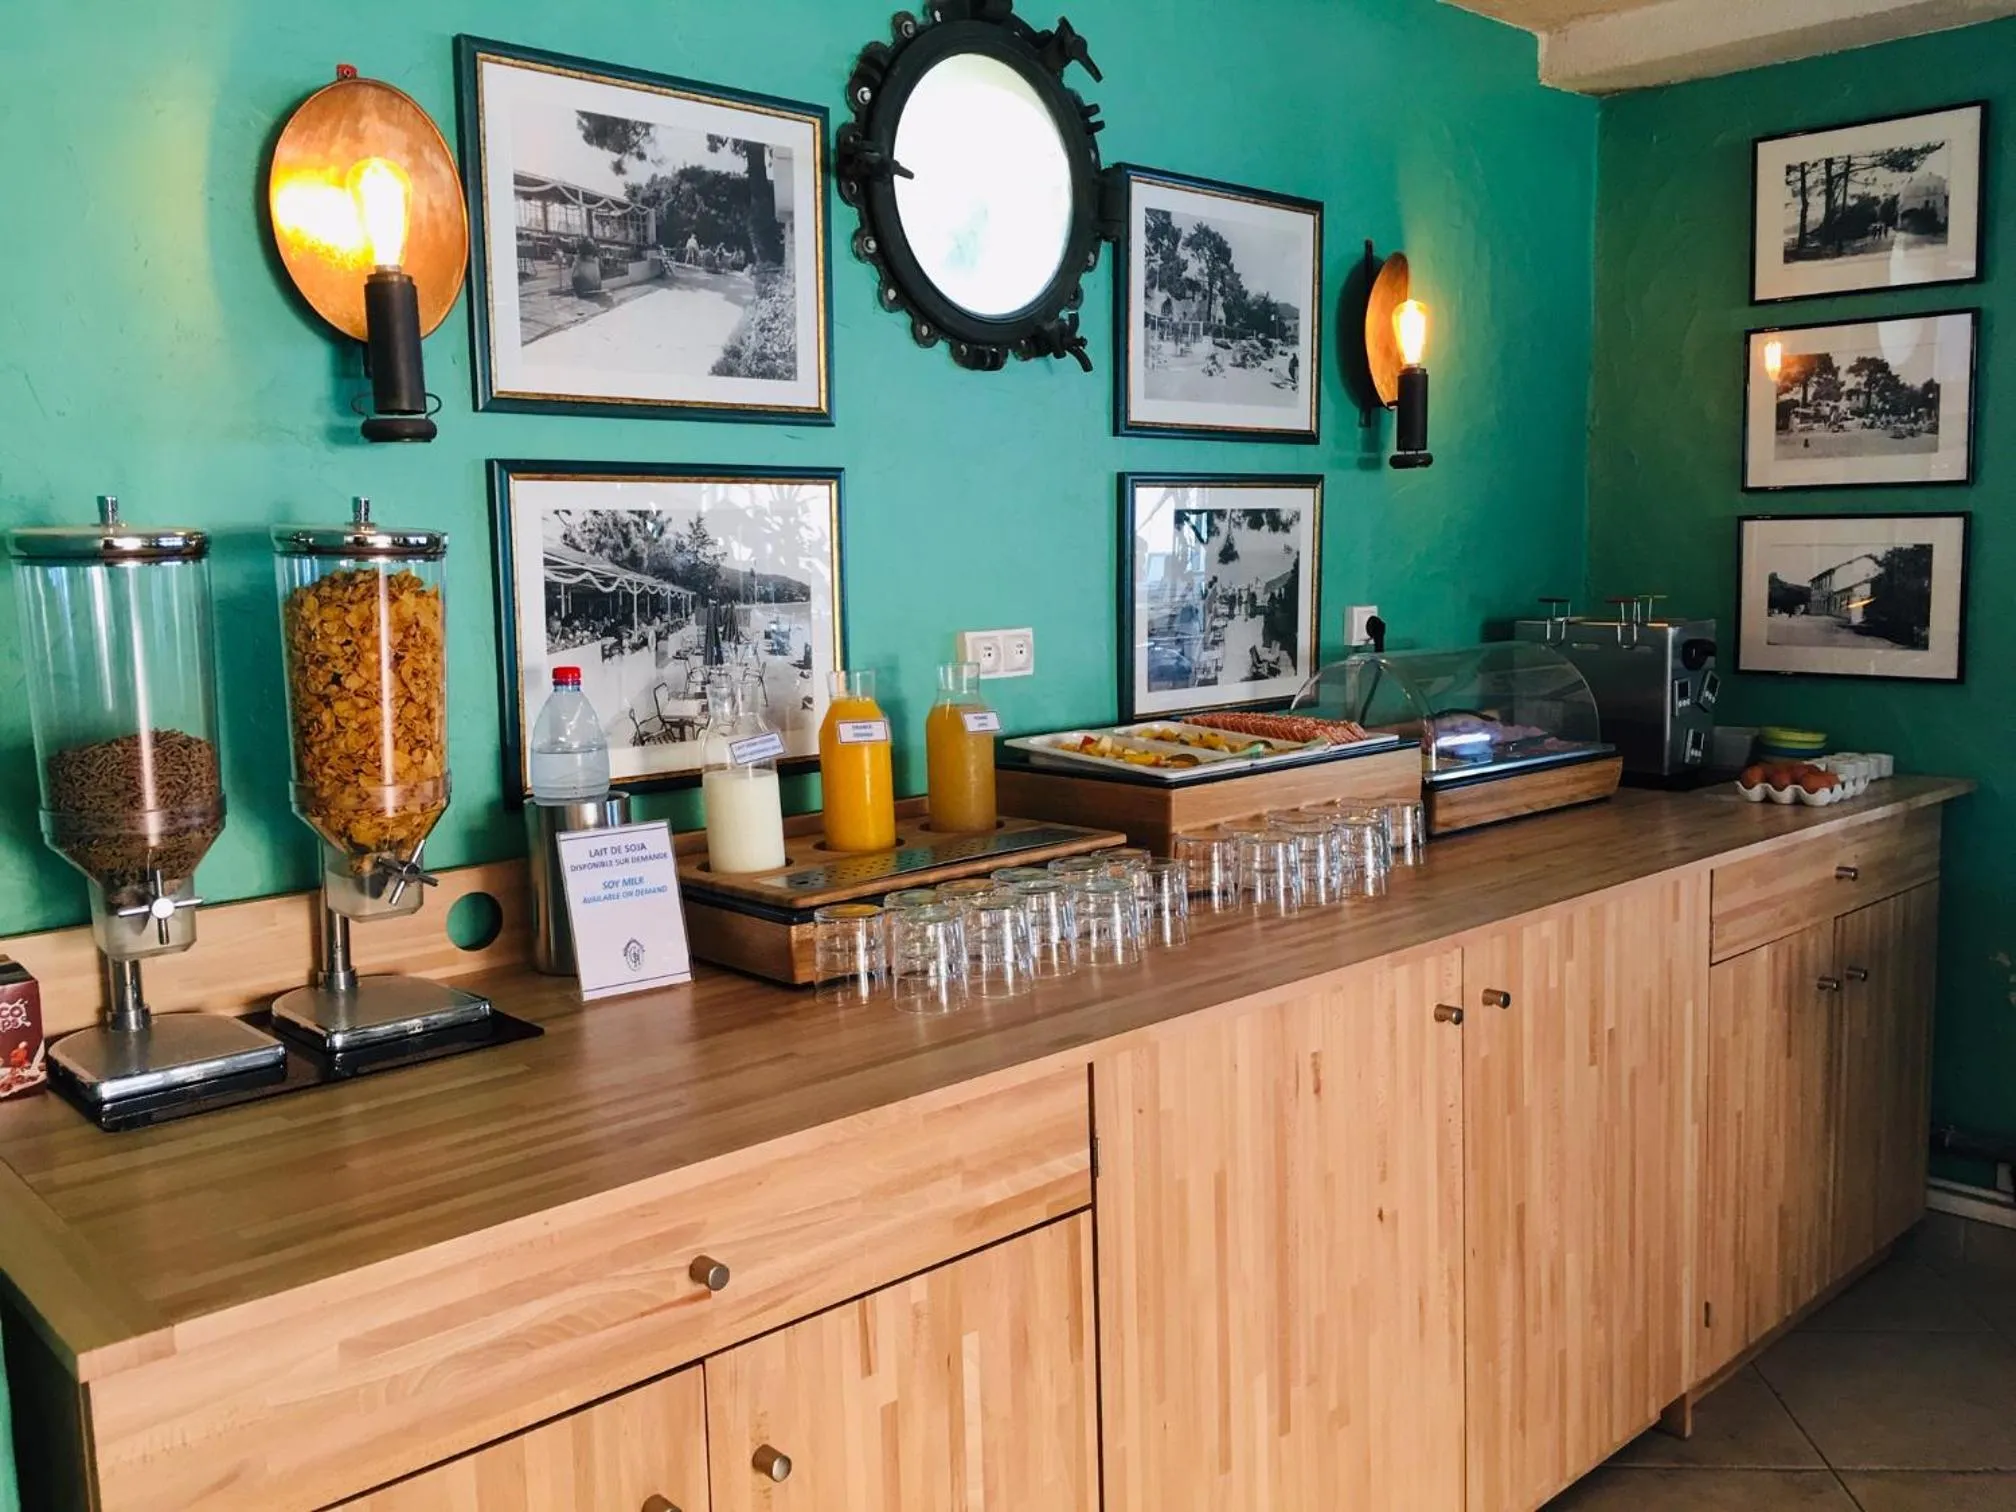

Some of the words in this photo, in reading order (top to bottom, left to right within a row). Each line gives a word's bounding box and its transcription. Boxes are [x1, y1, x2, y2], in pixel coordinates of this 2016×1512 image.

[589, 847, 608, 858] LAIT
[610, 845, 622, 855] DE
[625, 842, 647, 852] SOJA
[570, 861, 613, 872] DISPONIBLE
[615, 858, 630, 866] SUR
[631, 852, 668, 863] DEMANDE
[602, 879, 620, 889] SOY
[622, 876, 645, 886] MILK
[582, 893, 620, 904] AVAILABLE
[635, 885, 668, 896] DEMAND
